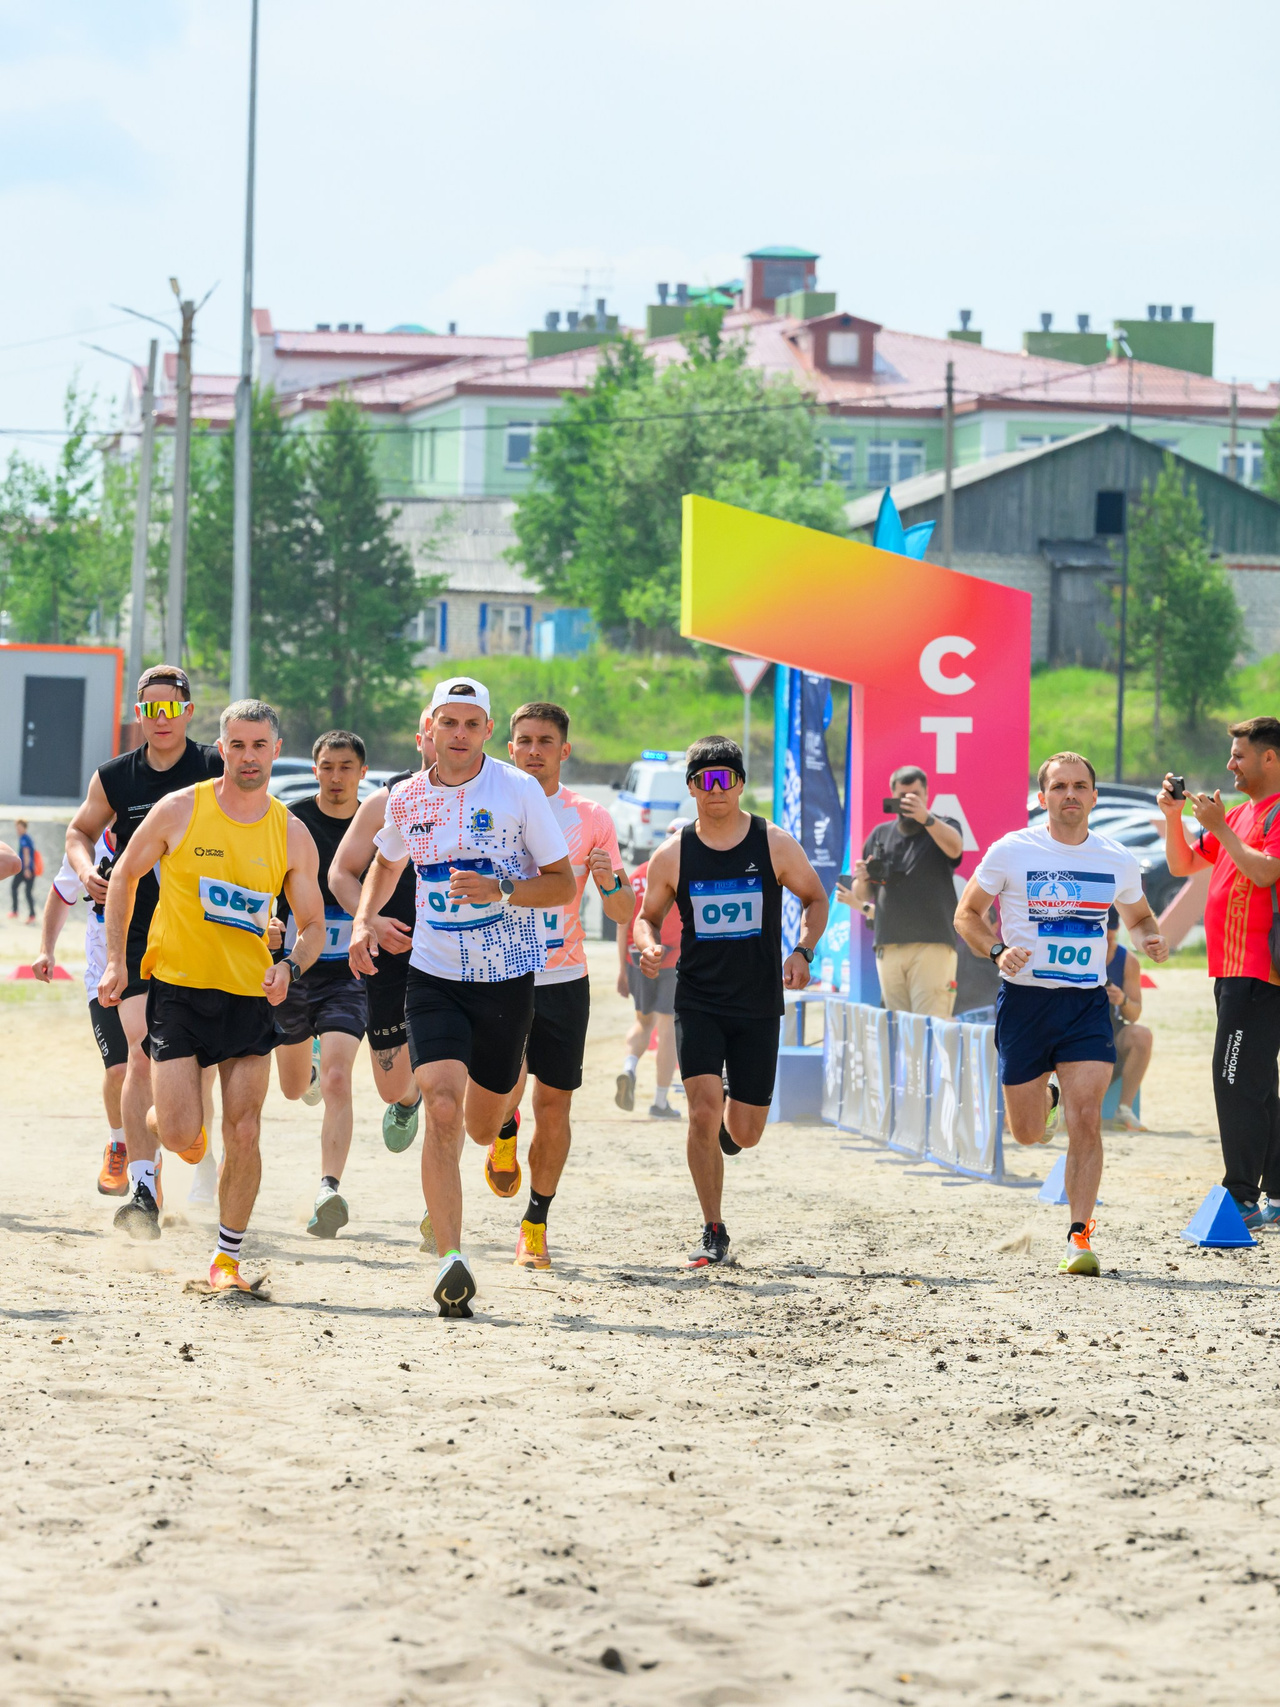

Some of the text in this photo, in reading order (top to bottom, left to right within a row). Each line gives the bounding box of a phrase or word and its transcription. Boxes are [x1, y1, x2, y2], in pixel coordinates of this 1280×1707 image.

[208, 885, 265, 914] 067
[428, 890, 492, 913] 07
[702, 901, 752, 925] 091
[1047, 944, 1092, 966] 100
[1227, 1029, 1244, 1085] КРАСНОДАР
